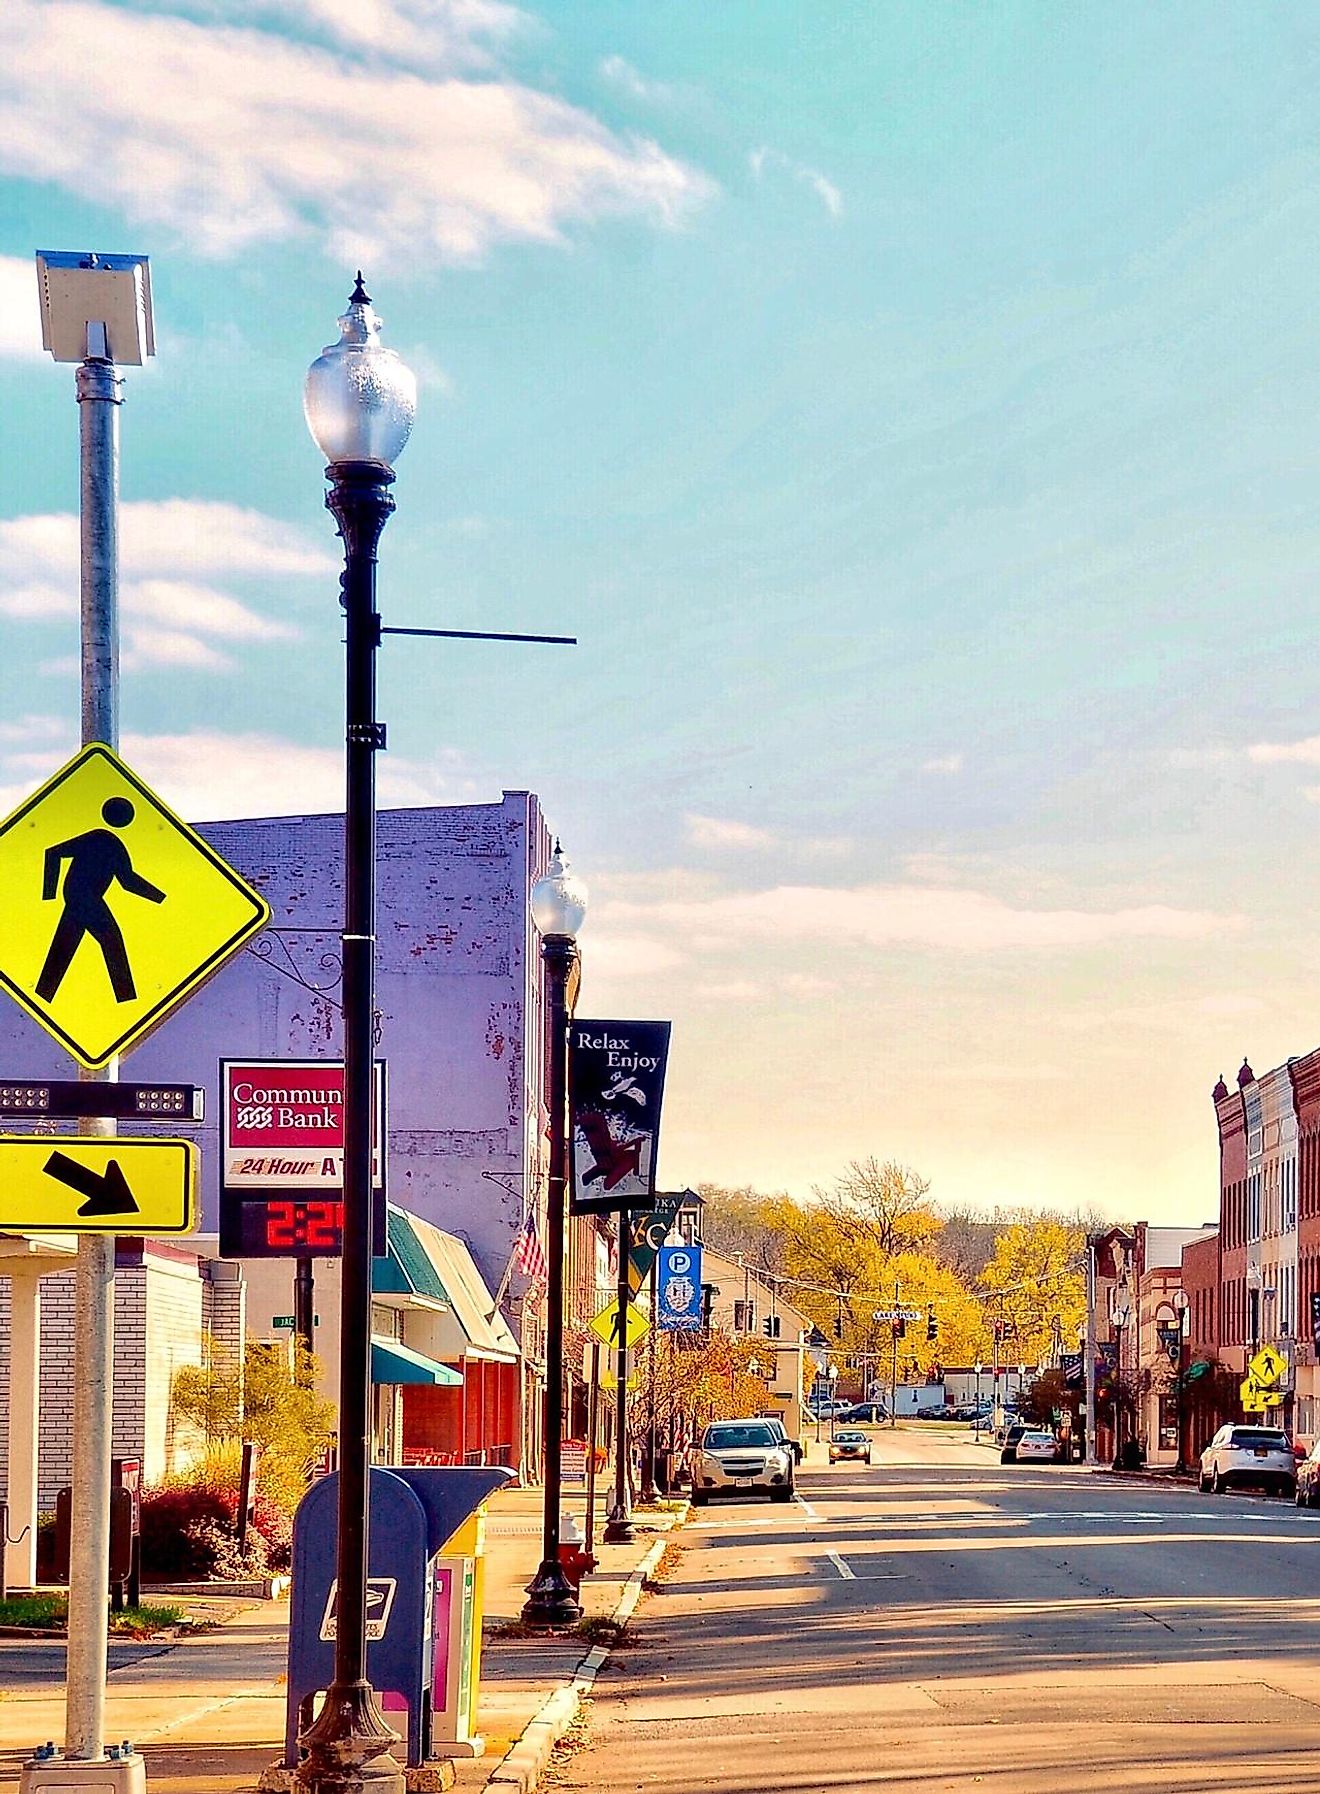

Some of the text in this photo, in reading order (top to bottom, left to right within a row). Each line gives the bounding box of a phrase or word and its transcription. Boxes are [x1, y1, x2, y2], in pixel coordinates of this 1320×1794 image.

[577, 1032, 630, 1050] Relax
[606, 1051, 661, 1073] Enjoy
[233, 1083, 343, 1104] Commun
[277, 1106, 340, 1128] Bank
[240, 1158, 264, 1175] 24
[267, 1158, 315, 1175] Hour
[267, 1201, 343, 1246] 2:2
[674, 1256, 686, 1270] P
